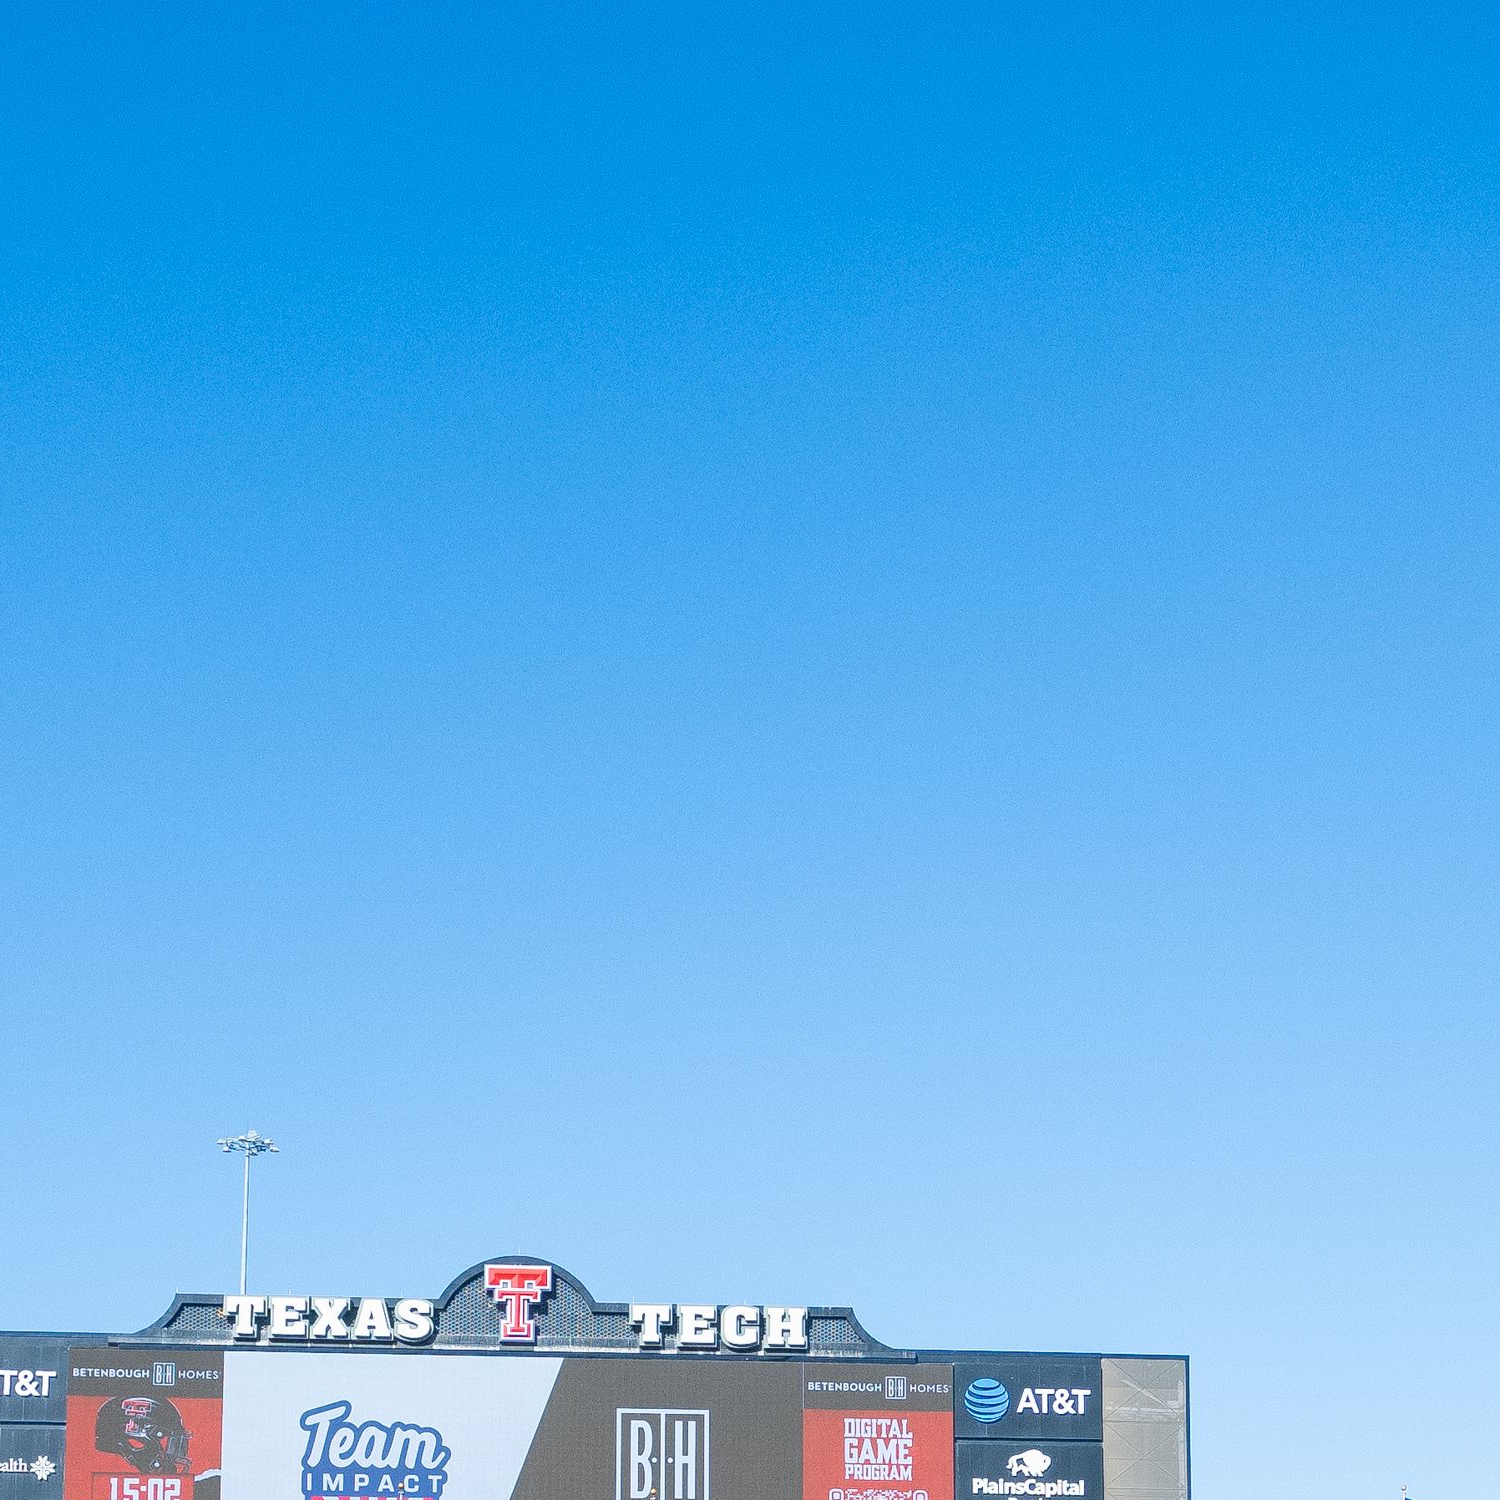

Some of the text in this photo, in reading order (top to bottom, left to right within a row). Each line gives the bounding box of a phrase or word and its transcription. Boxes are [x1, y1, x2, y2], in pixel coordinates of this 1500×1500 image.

[224, 1295, 437, 1344] TEXAS
[630, 1304, 807, 1350] TECH
[72, 1368, 149, 1379] BETENBOUGH
[807, 1382, 882, 1392] BETENBOUGH
[1016, 1388, 1092, 1415] AT&T
[304, 1405, 446, 1469] Team
[844, 1418, 913, 1438] DIGITAL
[844, 1438, 913, 1464] GAME
[845, 1464, 912, 1481] PROGRAM
[306, 1473, 443, 1493] IMPACT
[972, 1478, 1085, 1498] PlainsCapital
